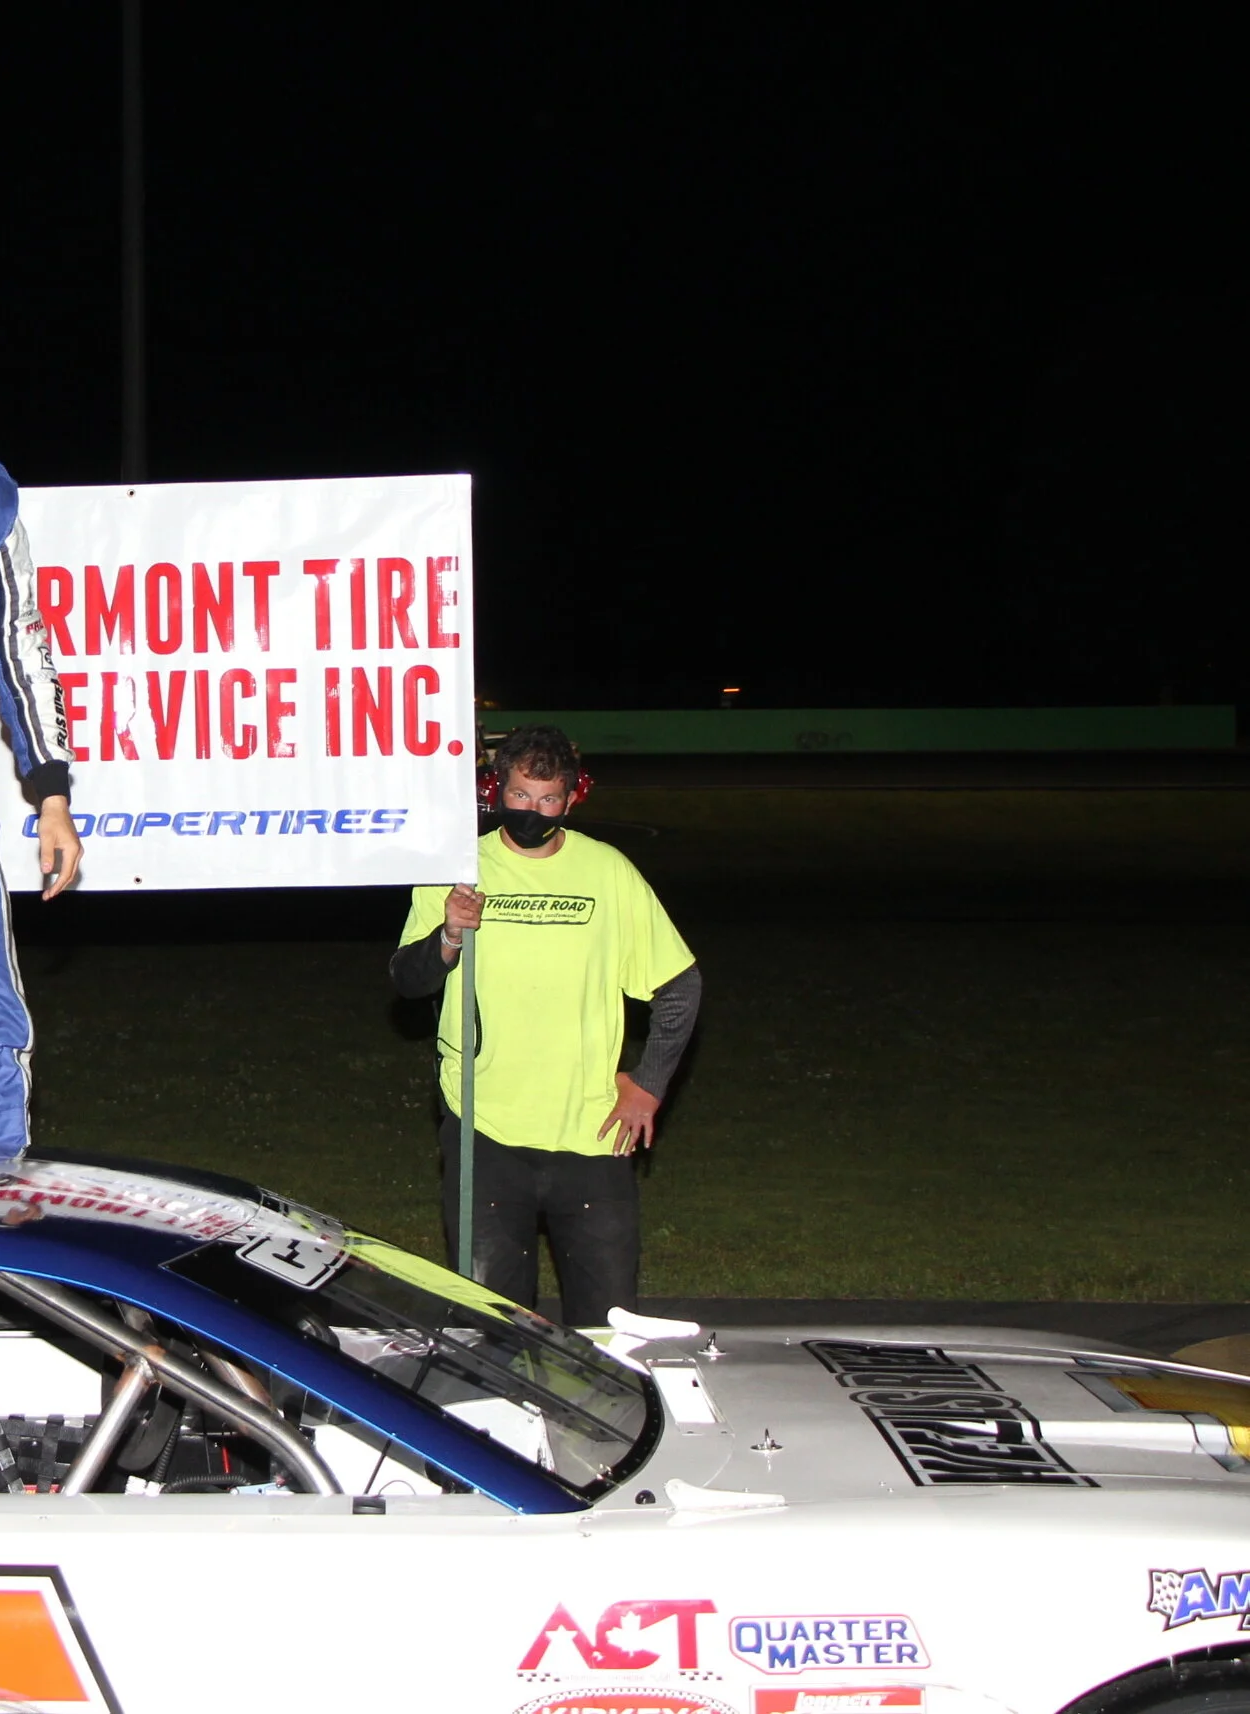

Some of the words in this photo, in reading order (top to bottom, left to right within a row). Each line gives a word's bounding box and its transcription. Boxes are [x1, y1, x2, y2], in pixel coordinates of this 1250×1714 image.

[36, 560, 280, 656] RMONT
[303, 556, 460, 651] TIRE
[59, 667, 298, 762] ERVICE
[325, 664, 464, 758] INC.
[486, 898, 549, 911] THUNDER
[550, 900, 587, 912] ROAD
[516, 1599, 719, 1670] ACT
[735, 1618, 909, 1654] QUARTER
[768, 1642, 920, 1669] MASTER
